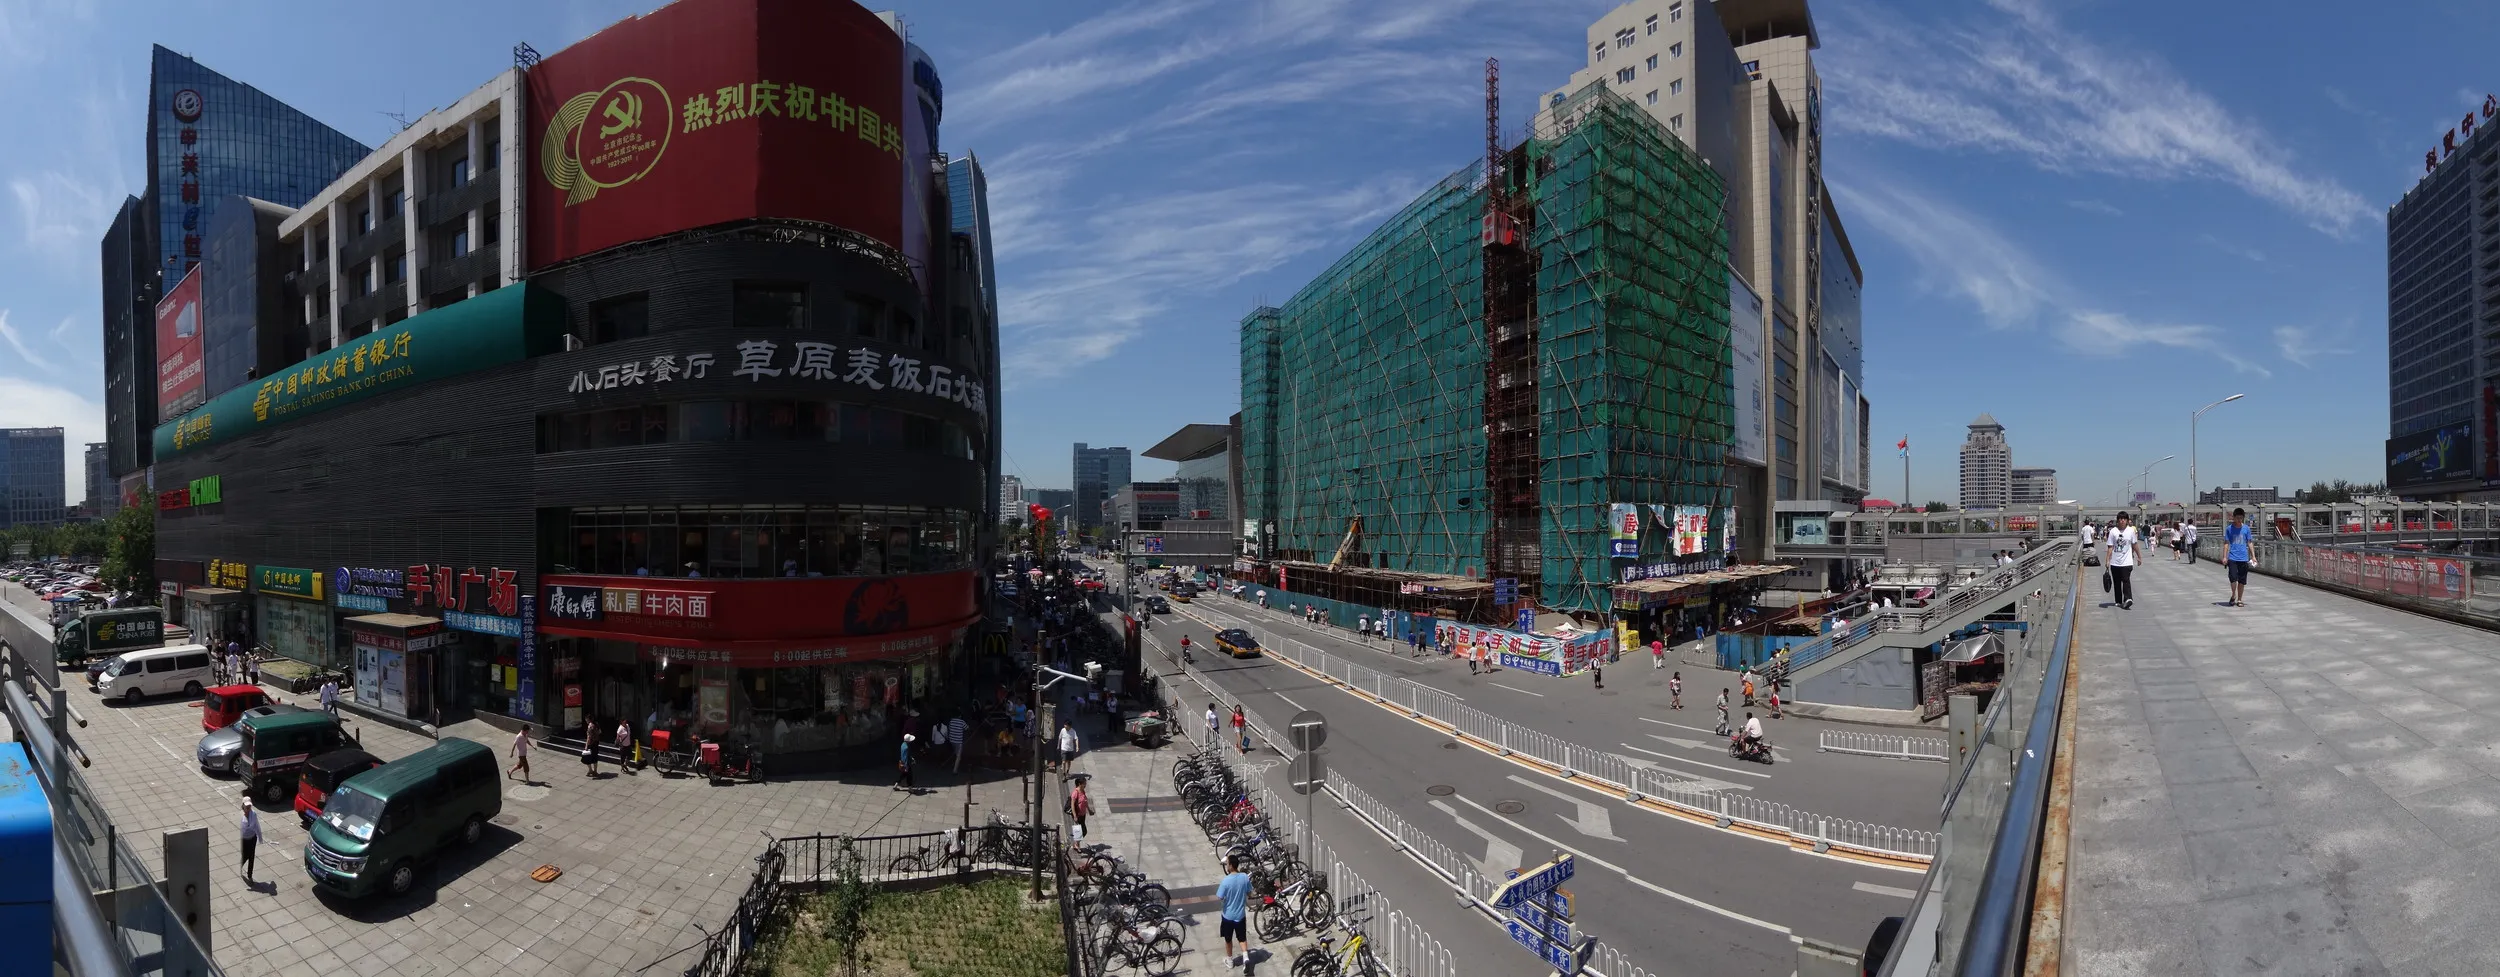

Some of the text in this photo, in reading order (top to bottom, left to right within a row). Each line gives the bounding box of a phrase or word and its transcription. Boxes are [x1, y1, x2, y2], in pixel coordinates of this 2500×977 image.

[273, 330, 412, 404] 中国邮政储蓄银行
[567, 353, 716, 394] 小石头餐厅
[274, 365, 414, 416] POSTAL SAVINGS BANK OF CHINA
[407, 563, 518, 616] 手机广场
[645, 594, 708, 618] 牛肉面
[116, 620, 156, 633] 中国邮政
[117, 629, 156, 640] CHINA POST
[520, 676, 535, 716] 广场
